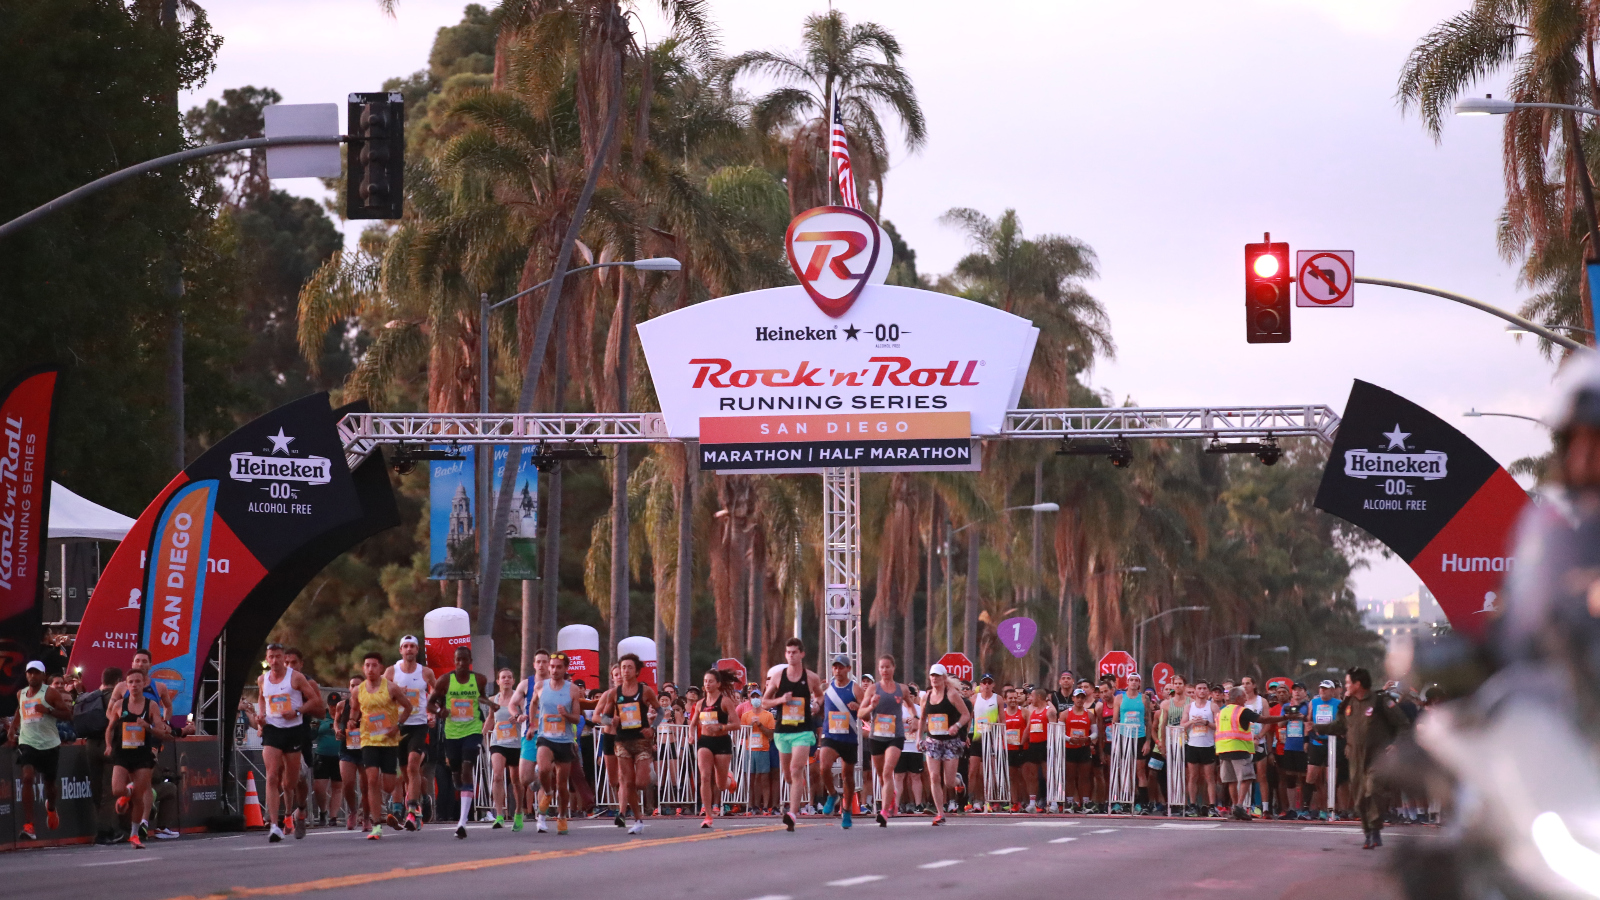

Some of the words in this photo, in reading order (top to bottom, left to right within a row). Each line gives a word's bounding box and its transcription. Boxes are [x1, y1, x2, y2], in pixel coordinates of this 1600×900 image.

[755, 326, 838, 342] Heineken
[687, 358, 824, 389] Rock
[868, 356, 980, 387] Roll
[719, 396, 843, 411] RUNNING
[851, 395, 948, 410] SERIES
[760, 422, 808, 435] SAN
[827, 420, 909, 434] DIEGO
[703, 448, 802, 463] MARATHON
[820, 447, 867, 461] HALF
[870, 445, 969, 460] MARATHON
[22, 433, 36, 494] SERIES
[236, 457, 325, 478] Heineken
[434, 461, 464, 478] Back!
[1350, 454, 1441, 473] Heineken
[248, 501, 288, 514] ALCOHOL
[291, 503, 312, 515] FREE
[1363, 499, 1403, 510] ALCOHOL
[1405, 500, 1427, 511] FREE
[17, 498, 32, 577] RUNNING
[167, 512, 193, 589] DIEGO
[160, 597, 181, 646] SAN
[105, 632, 138, 640] UNIT
[1012, 622, 1021, 641] 1
[92, 640, 138, 649] AIRLIN
[946, 664, 970, 679] TOP
[1101, 663, 1134, 678] STOP
[1158, 668, 1169, 685] 2
[61, 776, 93, 800] Heinek
